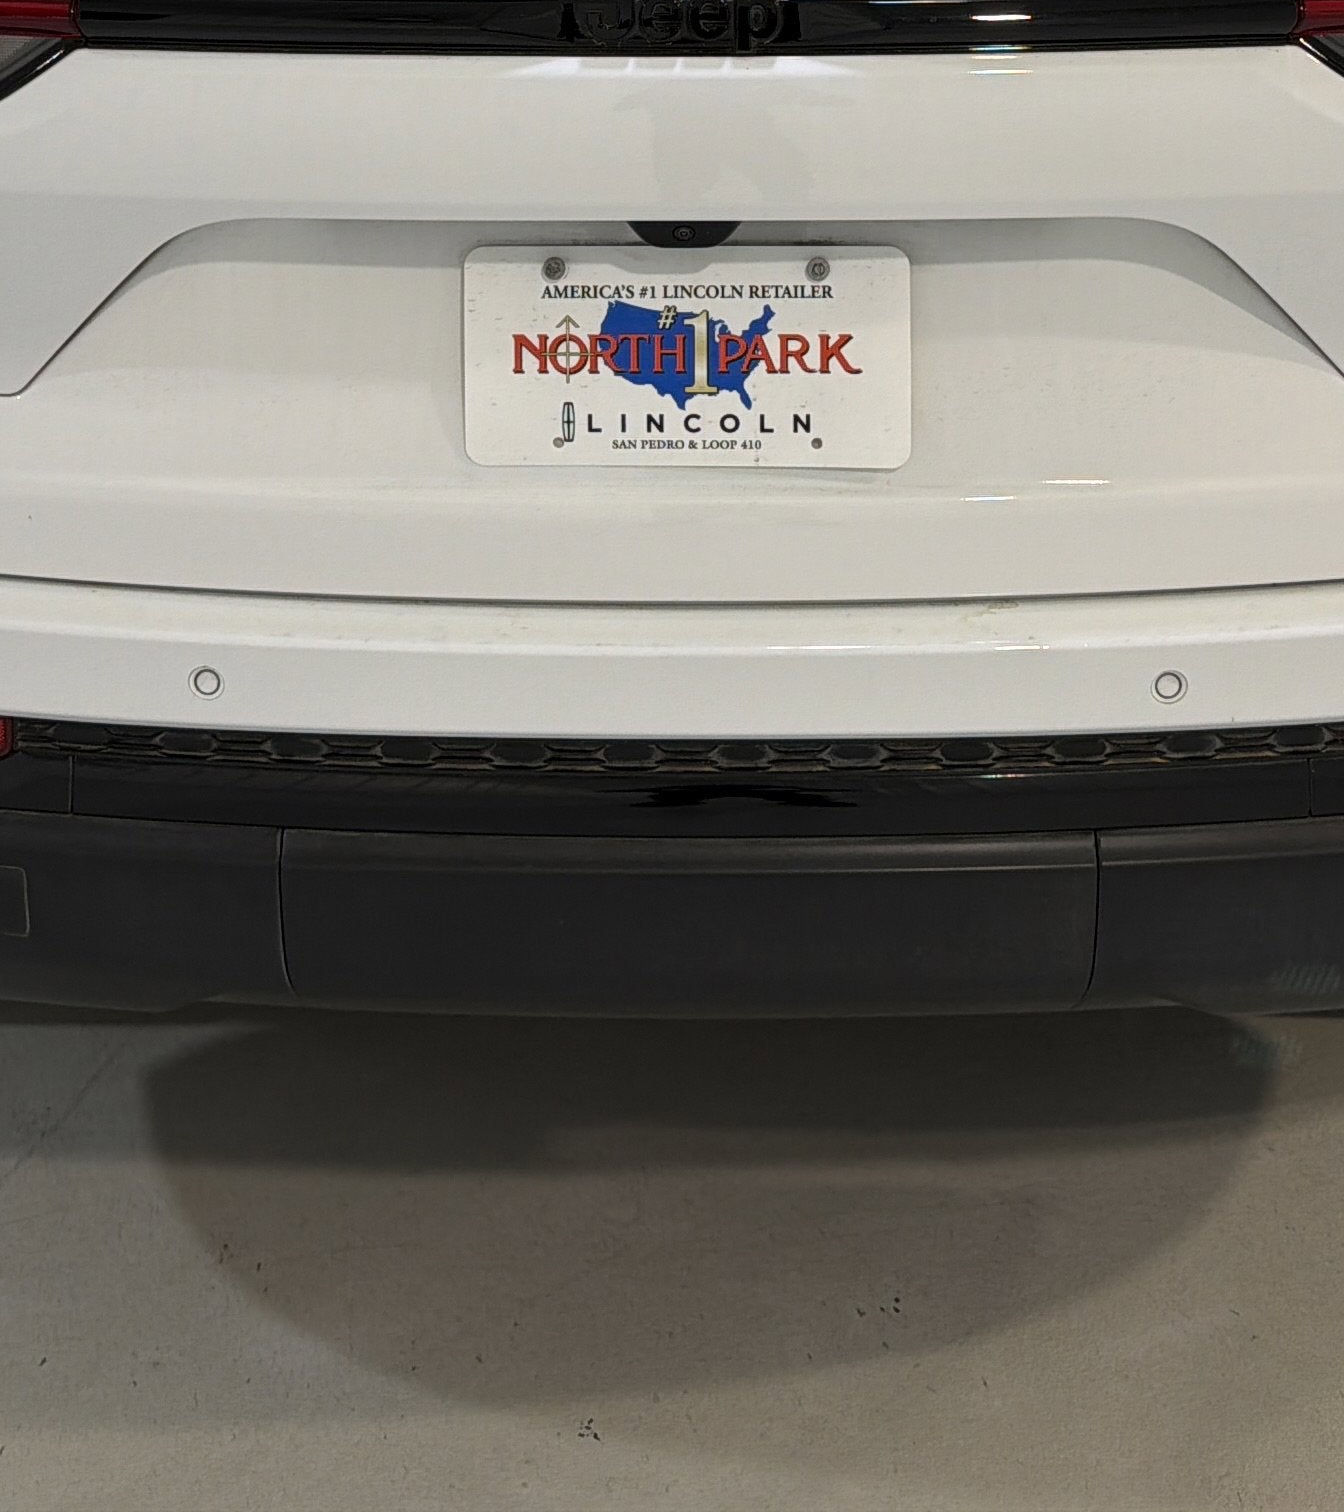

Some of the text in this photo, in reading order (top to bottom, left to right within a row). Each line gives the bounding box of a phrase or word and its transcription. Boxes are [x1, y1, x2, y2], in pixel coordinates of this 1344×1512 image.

[540, 284, 834, 299] AMERICA'S #1 LINCOLN RETAILER
[512, 333, 864, 375] NORTH PARK
[587, 413, 812, 434] LINCOLN
[611, 439, 762, 451] SAN PEDRO & LOOP 410
